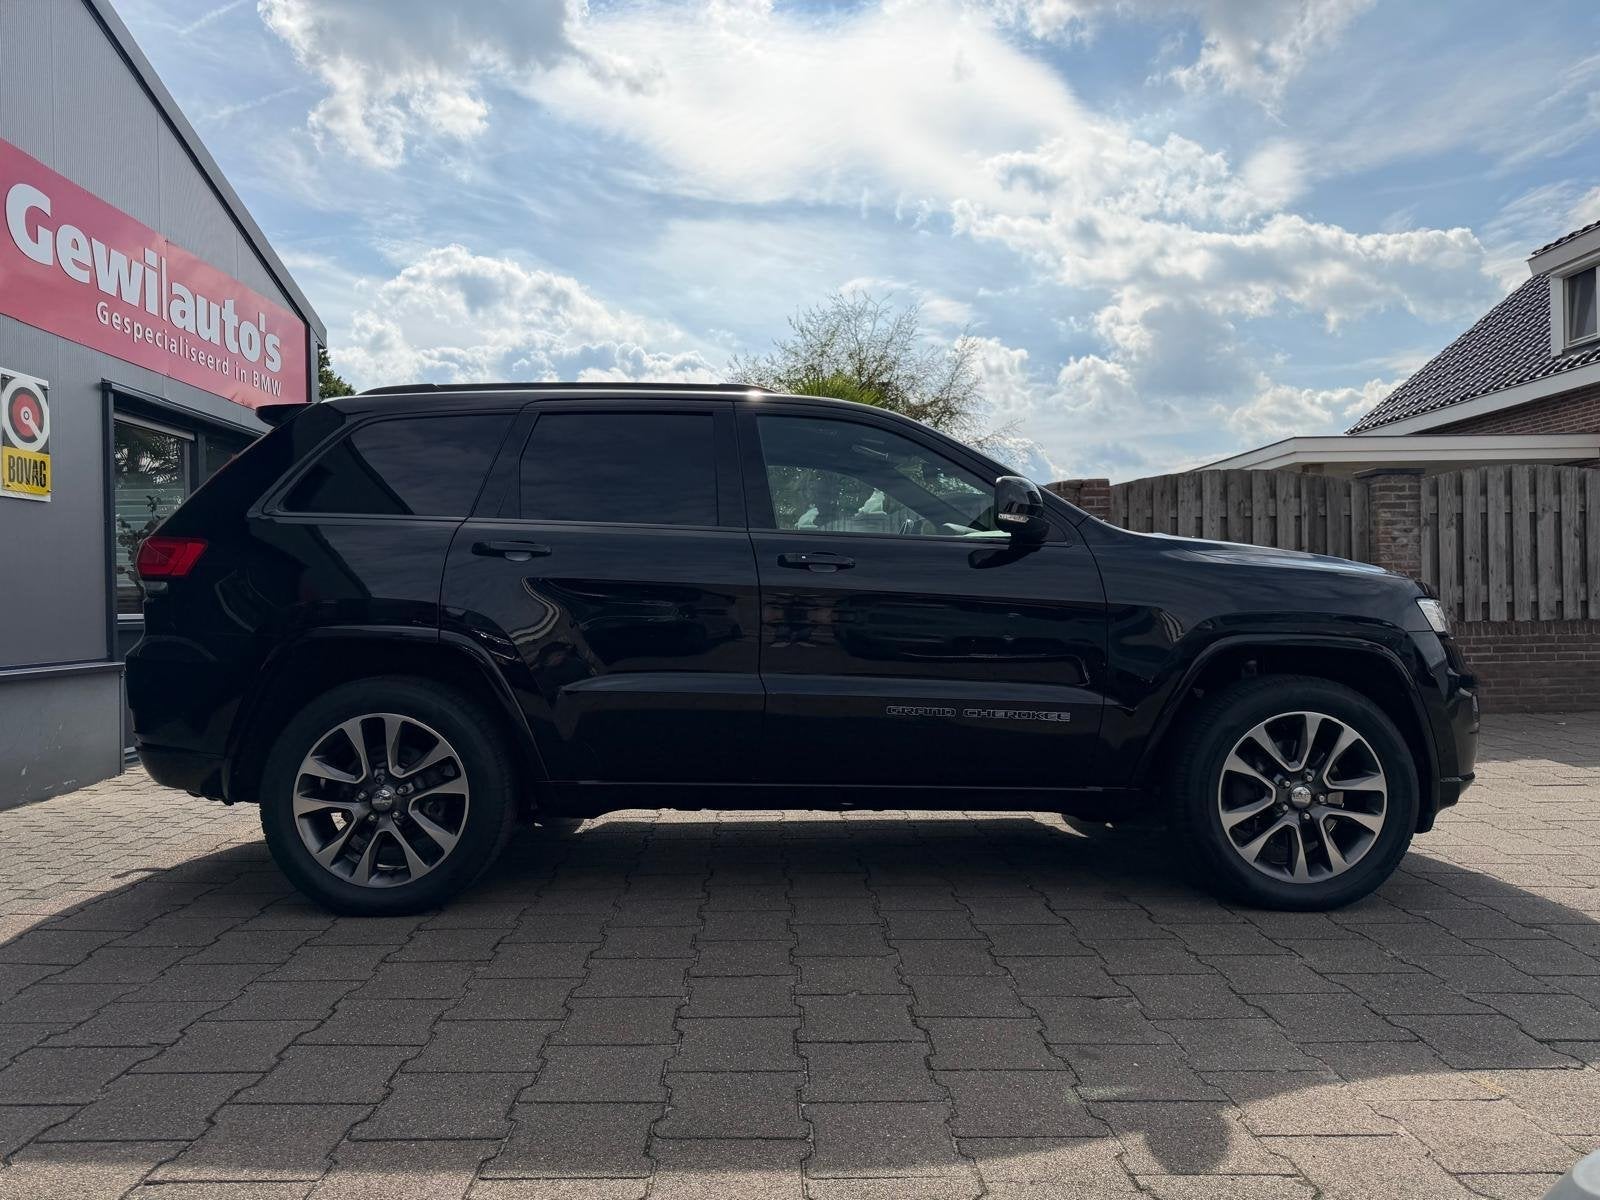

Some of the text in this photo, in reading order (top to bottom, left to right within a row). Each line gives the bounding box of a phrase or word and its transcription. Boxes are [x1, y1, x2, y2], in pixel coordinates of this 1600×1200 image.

[96, 301, 281, 397] Gespecialiseerd in BMW
[8, 455, 47, 488] BOVAG
[886, 705, 1071, 722] GRAND CHEROKEE
